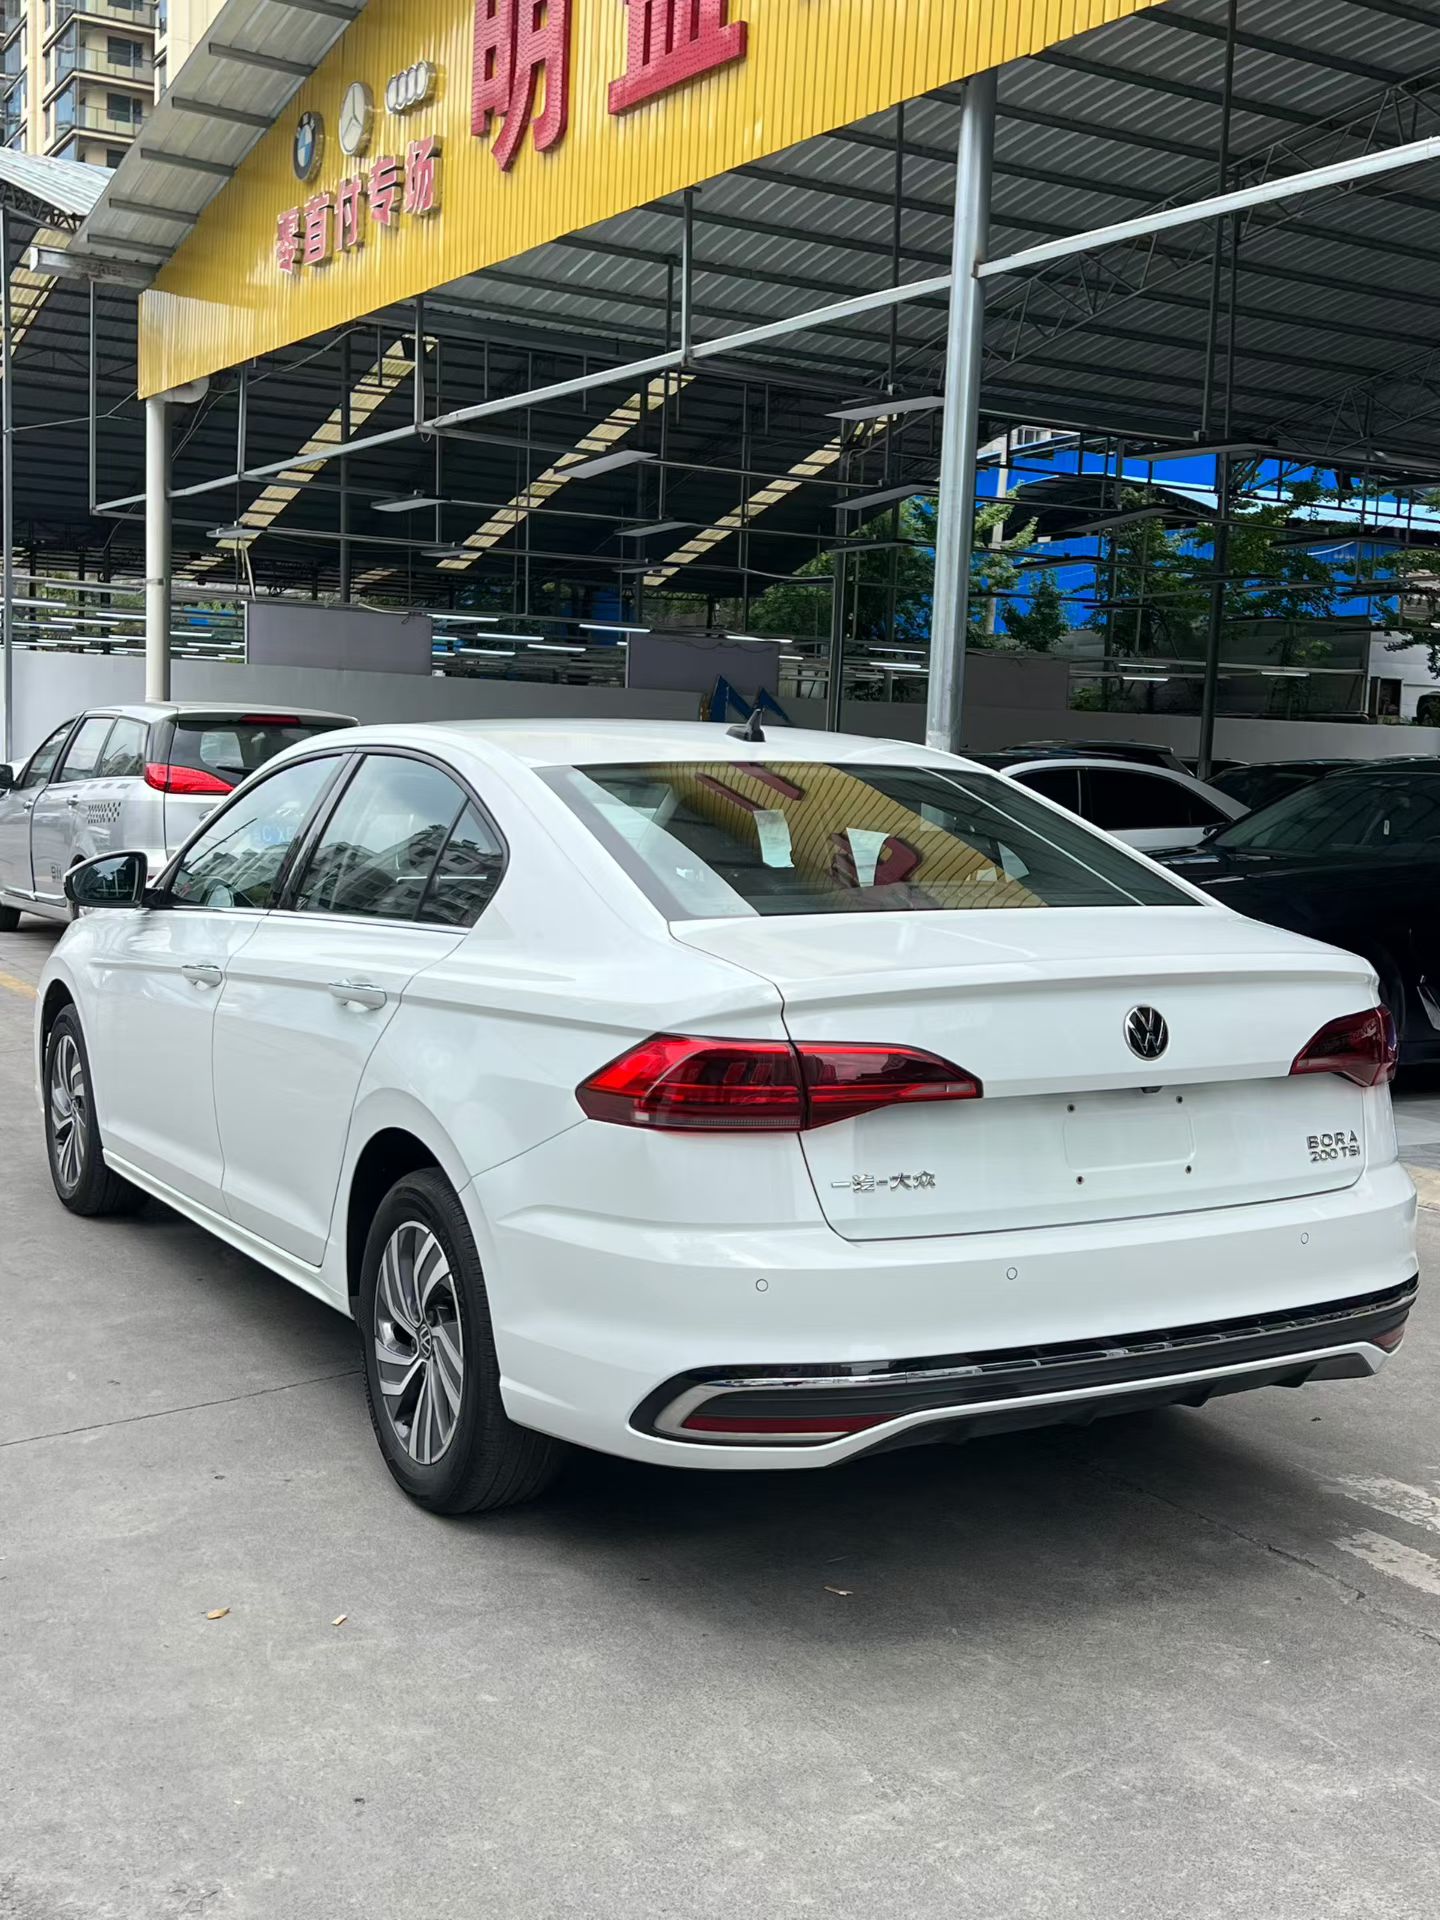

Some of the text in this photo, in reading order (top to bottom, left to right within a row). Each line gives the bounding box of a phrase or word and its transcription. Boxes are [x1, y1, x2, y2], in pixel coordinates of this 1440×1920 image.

[275, 135, 440, 274] 零首付专场
[1306, 1130, 1358, 1149] BORA
[1310, 1145, 1361, 1163] 200 TSI
